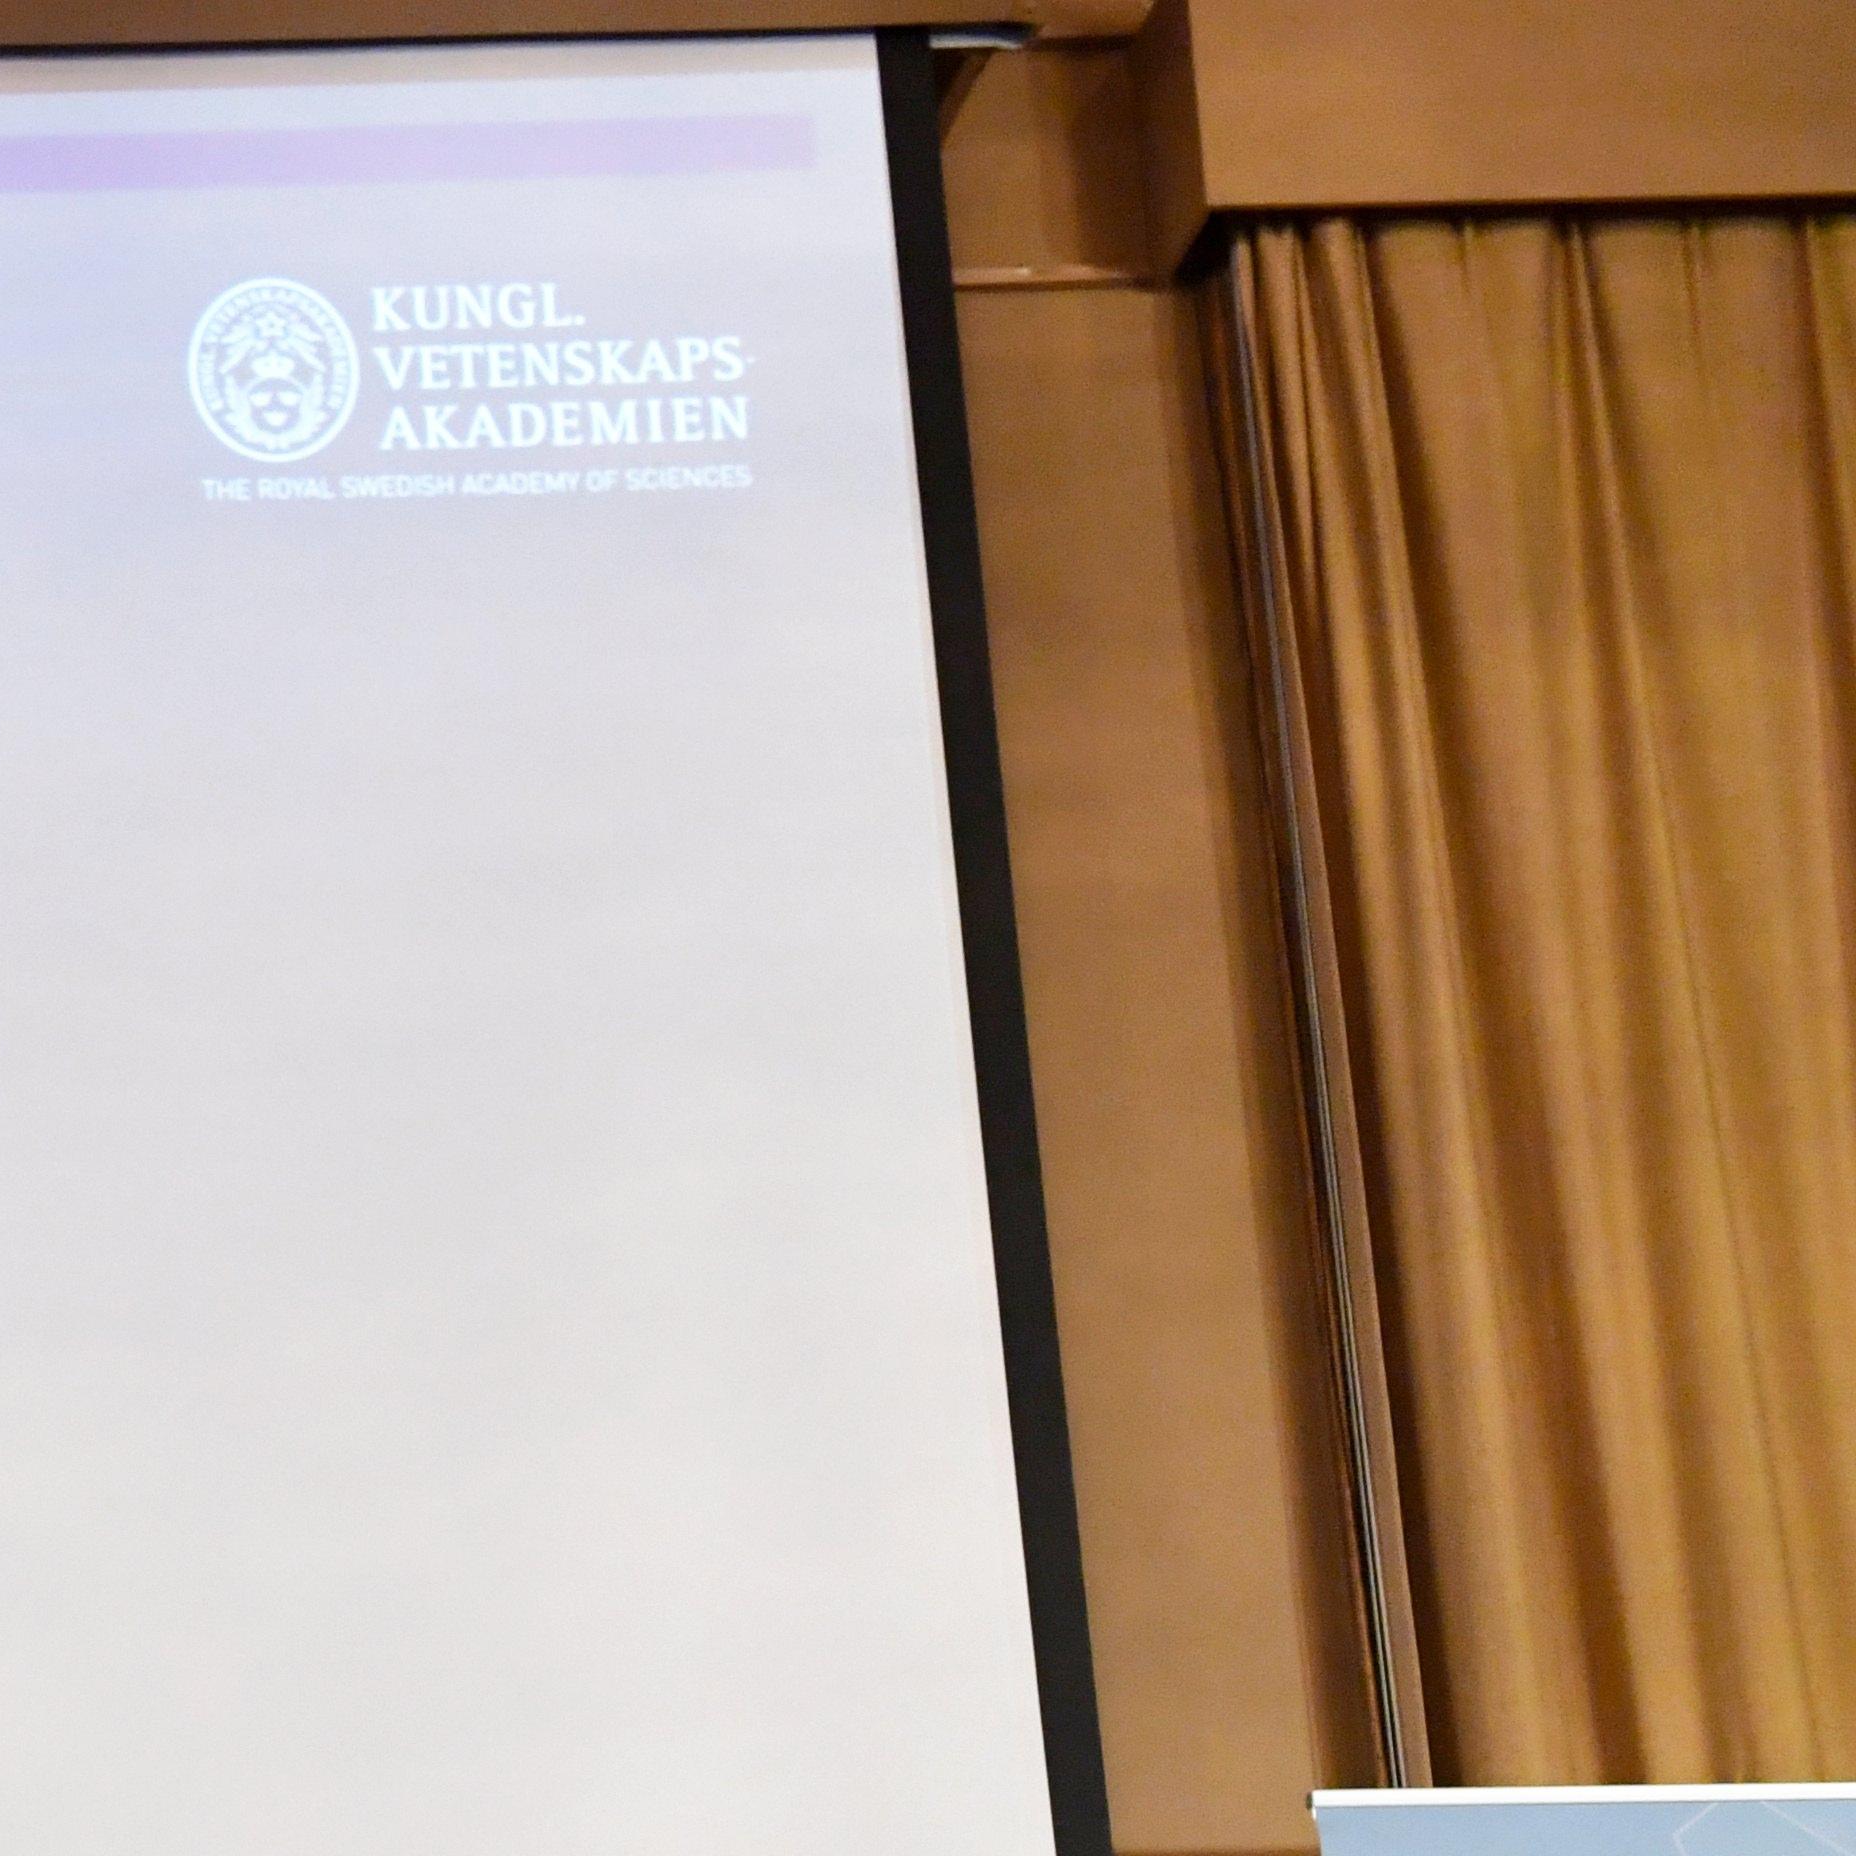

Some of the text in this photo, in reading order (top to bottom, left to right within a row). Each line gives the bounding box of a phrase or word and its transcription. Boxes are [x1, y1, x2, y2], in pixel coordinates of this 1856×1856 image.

[371, 282, 586, 332] KUNGL.
[379, 395, 749, 451] AKADEMIEN
[201, 464, 754, 502] THE ROYAL SWEDISH ACADEMY OF SCIENCES
